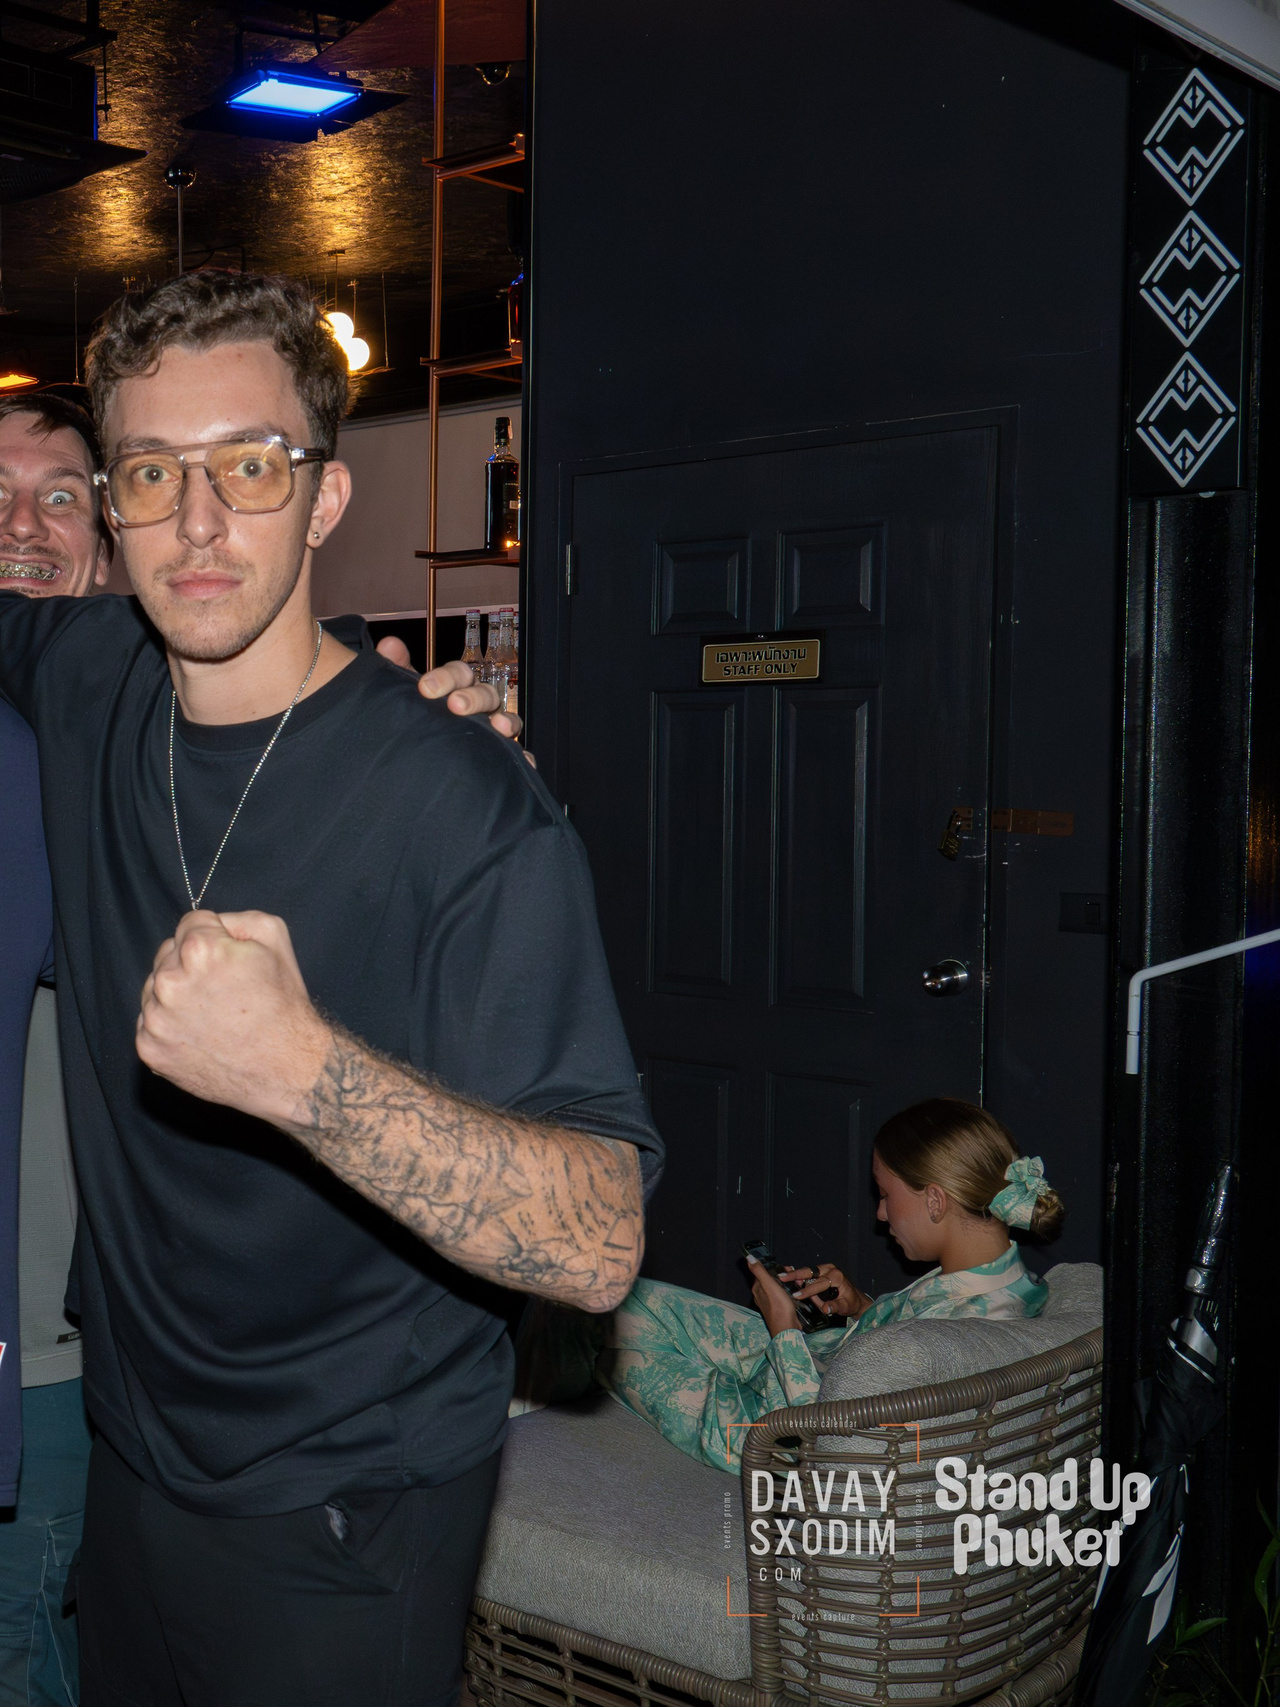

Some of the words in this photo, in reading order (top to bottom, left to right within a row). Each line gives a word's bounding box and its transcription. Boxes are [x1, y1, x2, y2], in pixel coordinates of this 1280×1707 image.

[716, 646, 807, 663] เฉพาะพนักงาน
[723, 664, 760, 676] STAFF
[765, 662, 798, 674] ONLY
